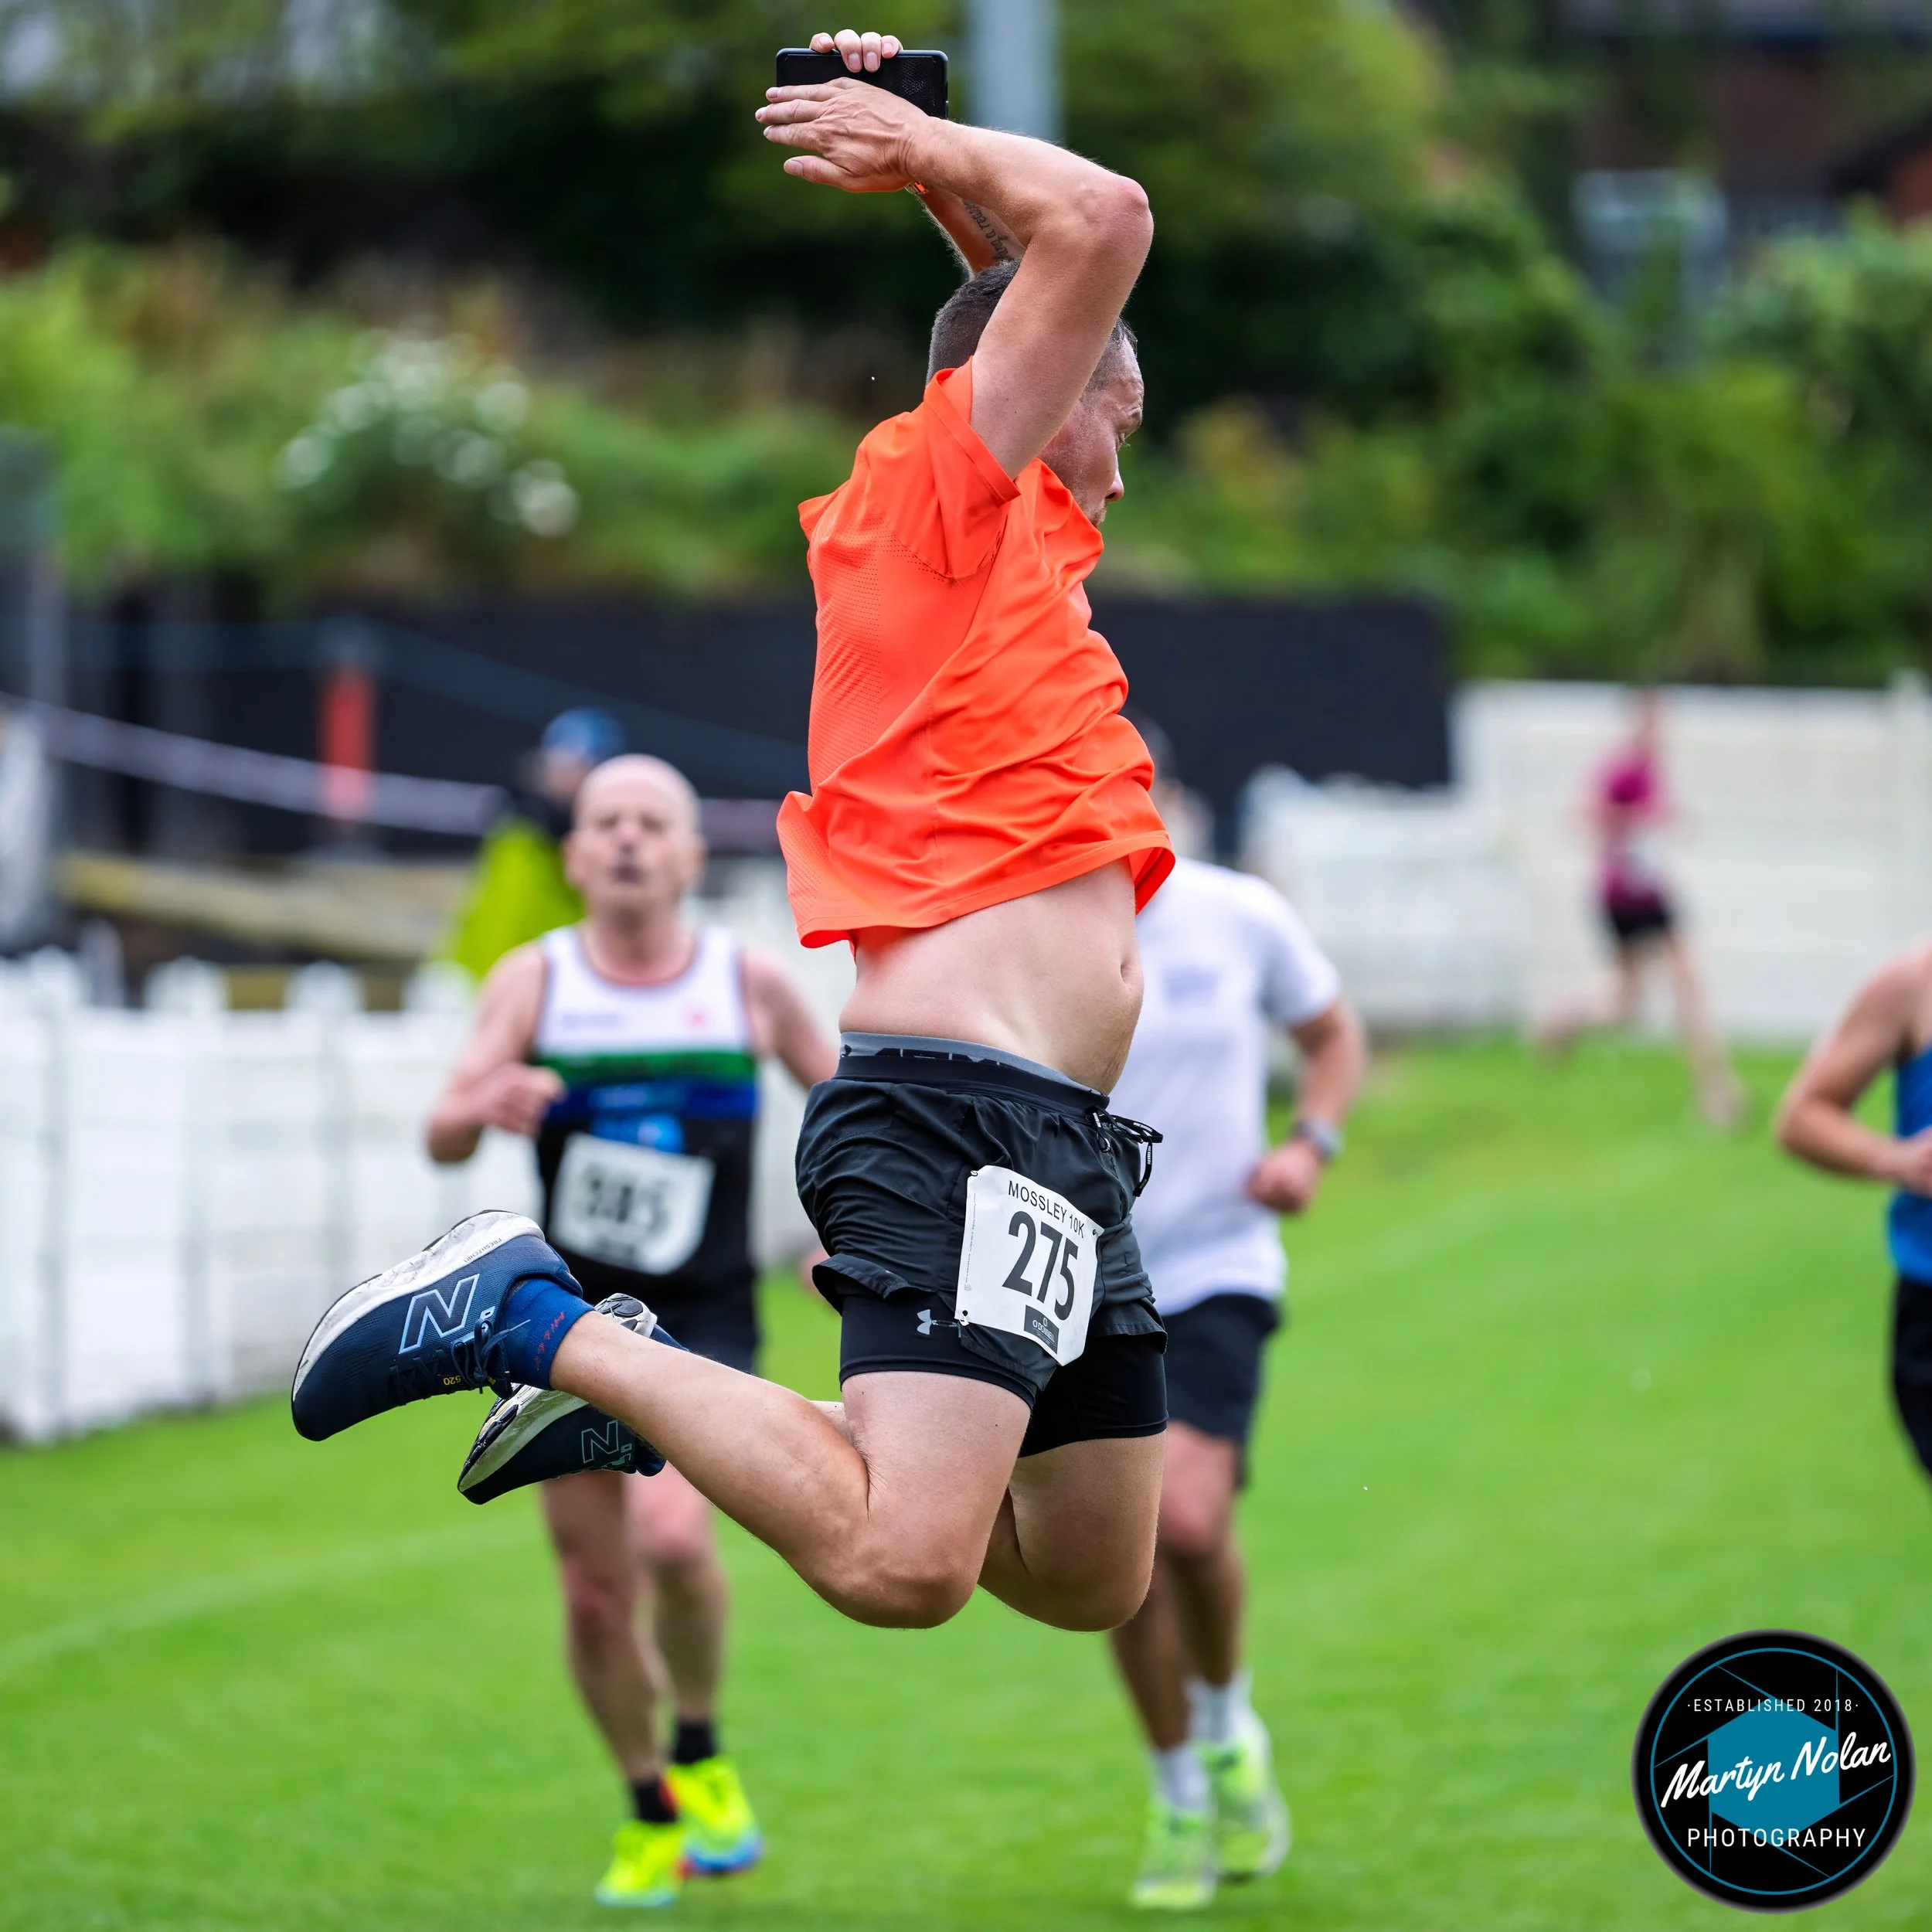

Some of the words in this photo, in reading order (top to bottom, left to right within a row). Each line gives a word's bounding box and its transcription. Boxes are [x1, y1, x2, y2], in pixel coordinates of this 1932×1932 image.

[1008, 1180, 1067, 1223] MOSSLEY
[1069, 1213, 1085, 1239] 10K
[1002, 1210, 1079, 1321] 275
[443, 1375, 461, 1386] 520
